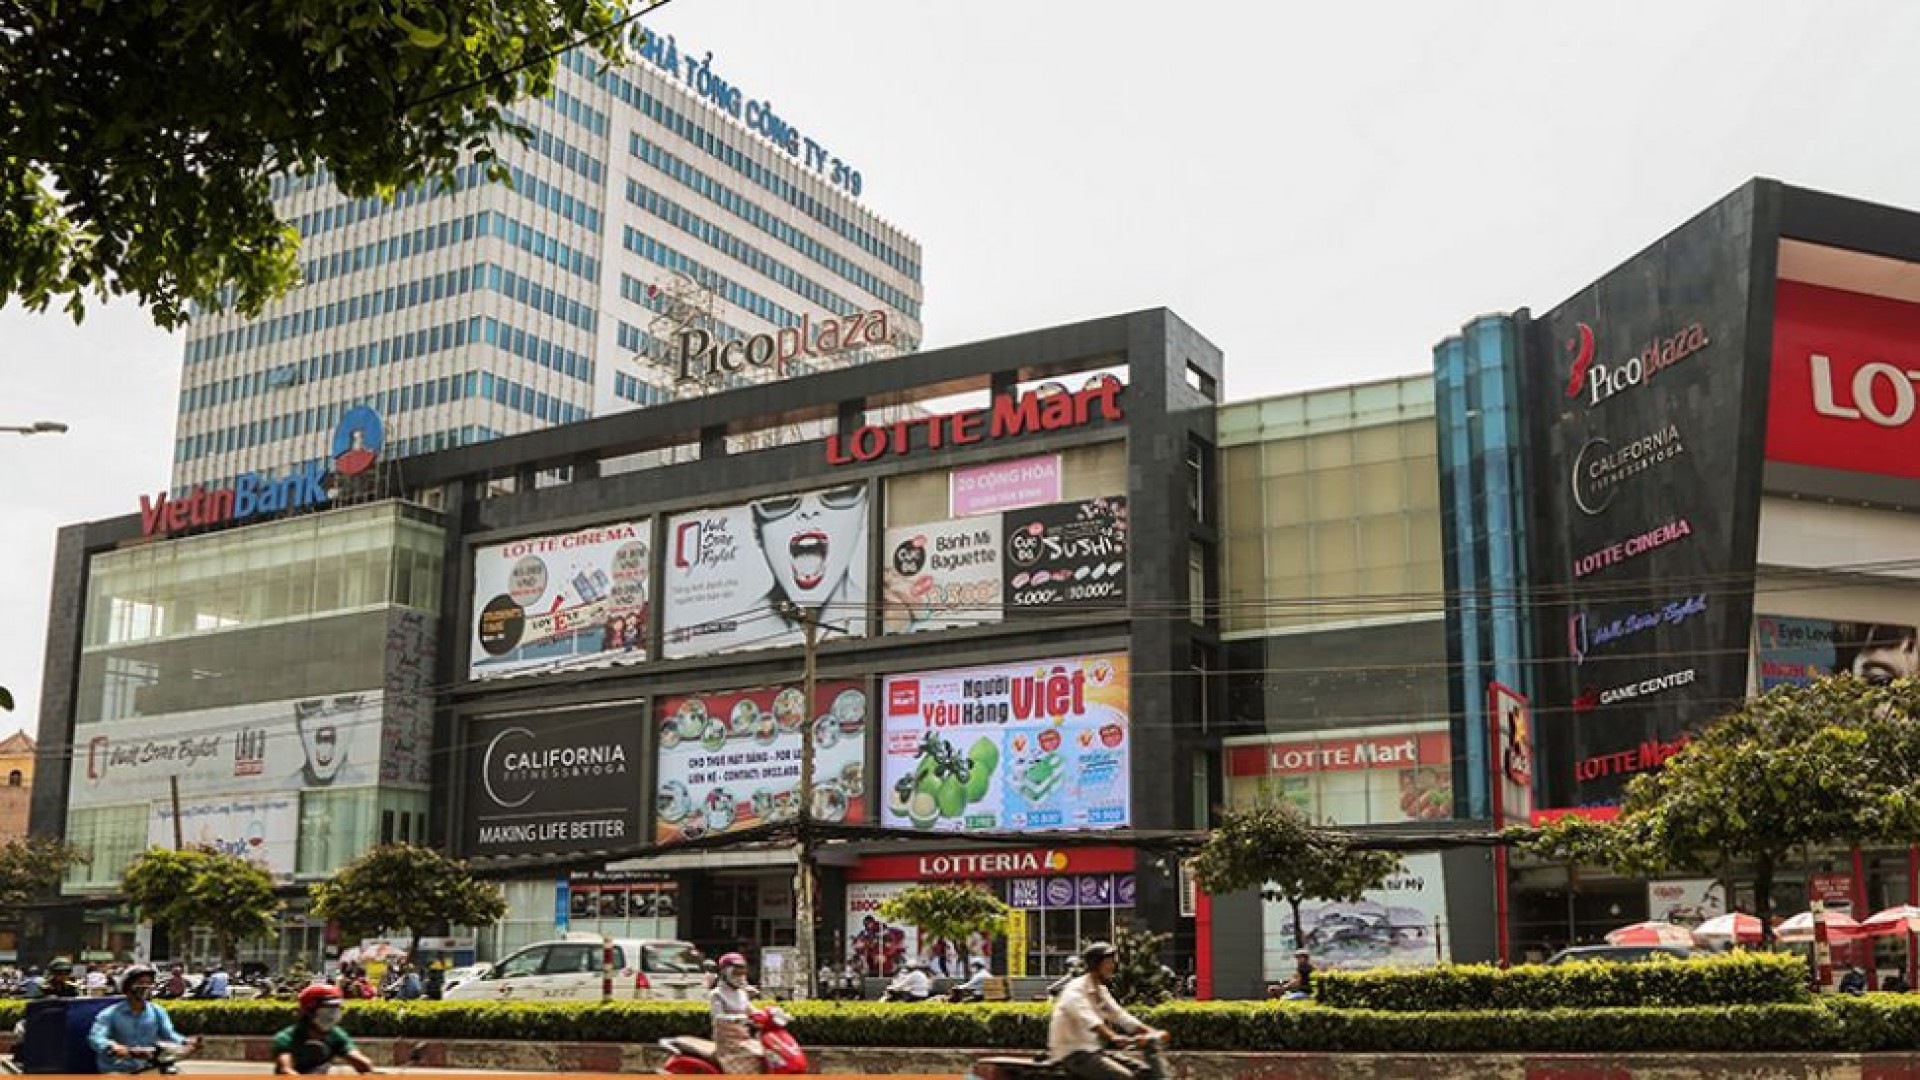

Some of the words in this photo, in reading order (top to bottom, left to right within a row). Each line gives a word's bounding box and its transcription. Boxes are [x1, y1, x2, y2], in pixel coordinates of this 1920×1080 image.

[685, 51, 742, 119] TỔNG
[745, 99, 799, 157] CÔNG
[803, 137, 829, 174] TY
[831, 158, 862, 197] 319
[1588, 322, 1705, 406] Picoplaza
[1810, 353, 1920, 428] LO
[825, 407, 986, 465] LOTTE
[989, 374, 1124, 439] Mart
[1589, 423, 1681, 479] CALIFORNIA
[139, 457, 329, 539] VietinBank
[956, 477, 975, 493] 20
[502, 536, 557, 559] LOTTE
[562, 525, 637, 549] CINEMA
[1042, 533, 1113, 561] SUSHI
[1573, 542, 1624, 578] LOTTE
[1624, 518, 1692, 557] CINEMA
[1778, 623, 1800, 641] Eye
[1600, 683, 1638, 705] GAME
[1638, 668, 1696, 695] CENTER
[503, 743, 626, 772] CALIFORNIA
[1271, 748, 1351, 770] LOTTE
[1352, 740, 1416, 764] Mart
[1574, 749, 1638, 783] LOTTE
[478, 823, 537, 844] MAKING
[538, 821, 568, 841] LIFE
[570, 819, 626, 840] BETTER
[918, 851, 1038, 876] LOTTERIA
